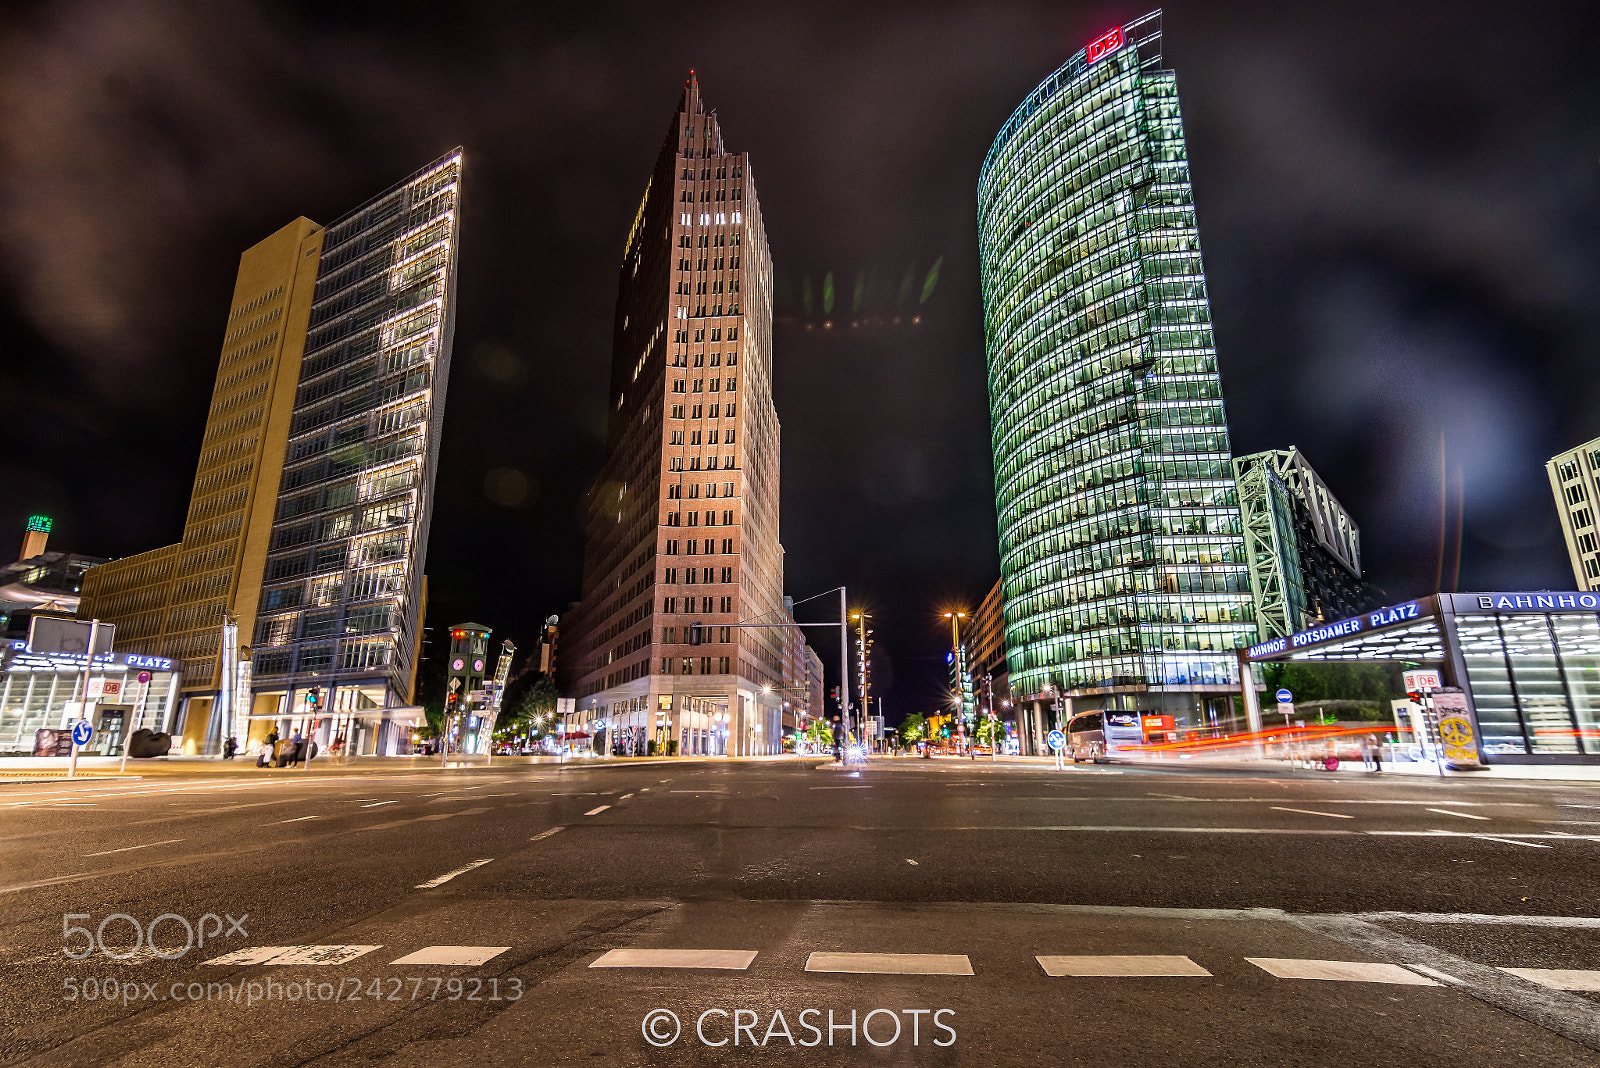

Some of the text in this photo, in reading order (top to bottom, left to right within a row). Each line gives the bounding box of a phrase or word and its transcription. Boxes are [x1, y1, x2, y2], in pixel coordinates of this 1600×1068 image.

[1090, 31, 1120, 61] DB
[1478, 594, 1598, 609] BAHNHO
[1246, 602, 1419, 658] BAHNHOF POTSDAMER PLATZ
[127, 654, 172, 669] PLATZ
[104, 683, 119, 693] DB
[1418, 676, 1436, 686] DB
